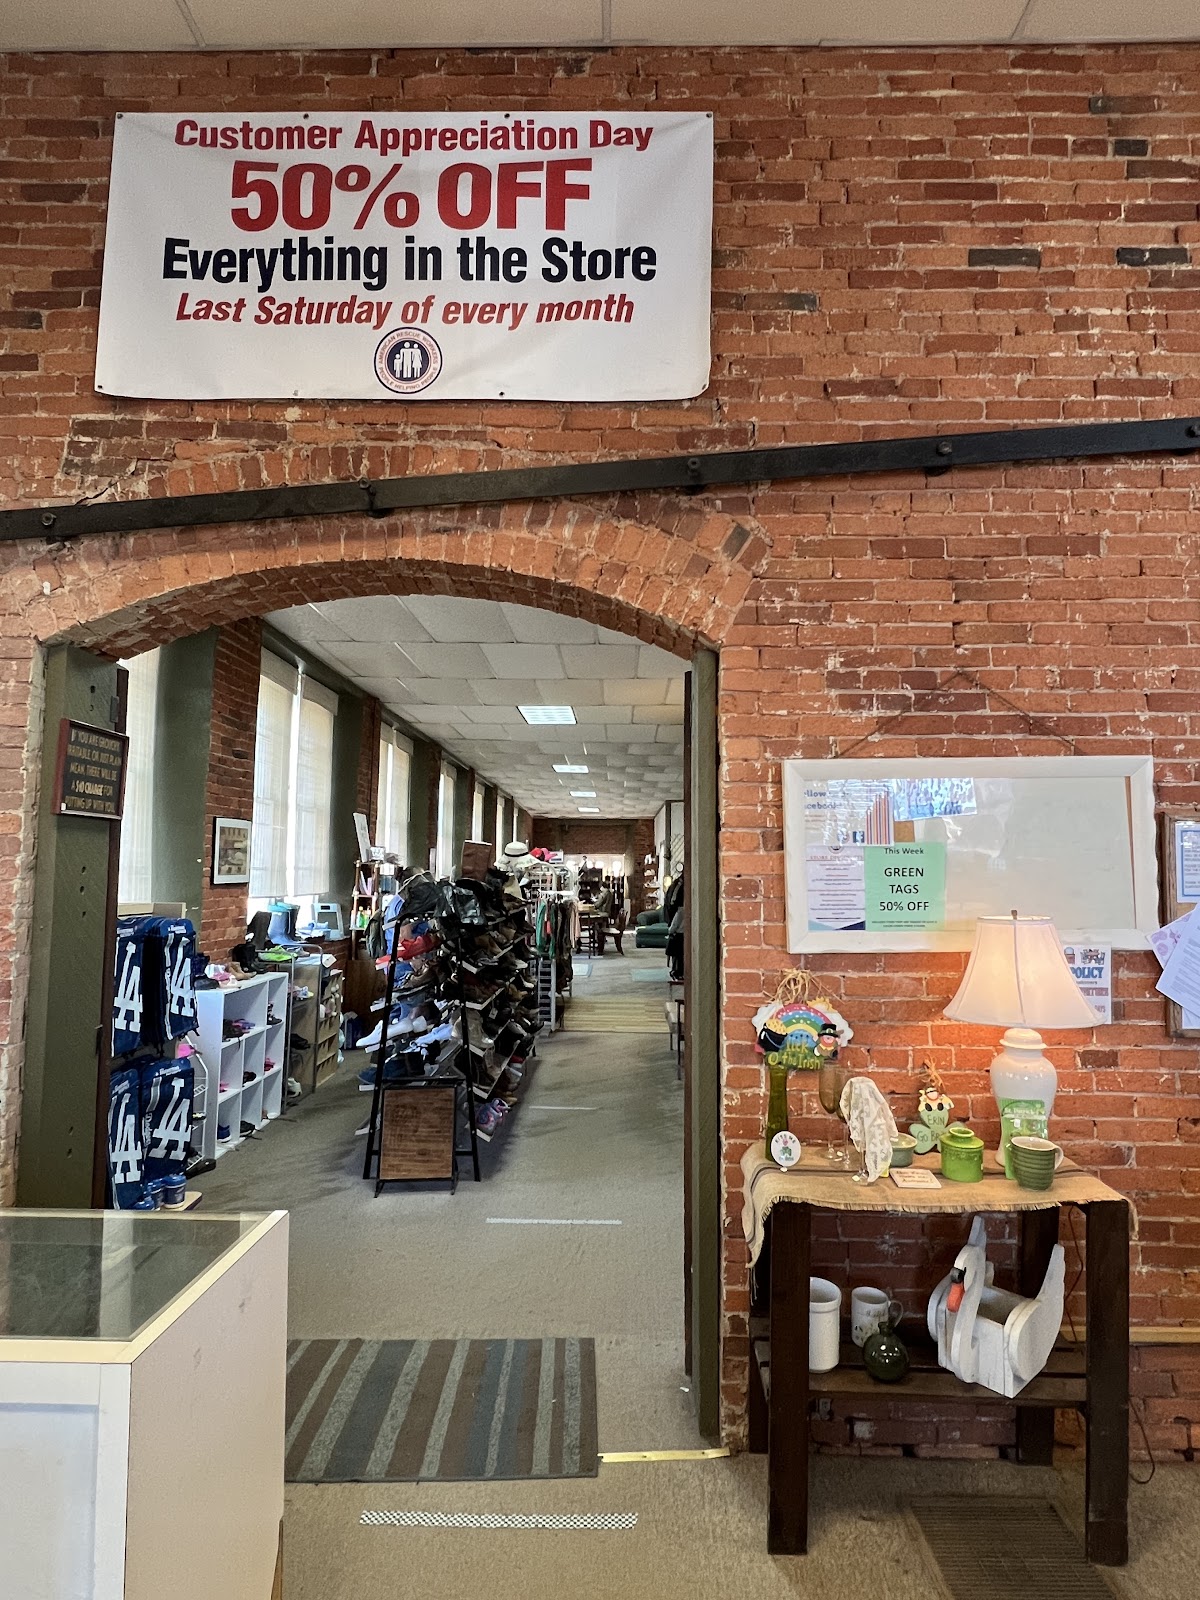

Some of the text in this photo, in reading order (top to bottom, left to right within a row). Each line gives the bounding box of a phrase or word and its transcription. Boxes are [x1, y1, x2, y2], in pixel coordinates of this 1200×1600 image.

[175, 120, 654, 157] Customer Appreciation Day
[231, 158, 593, 232] 50% OFF
[163, 235, 657, 292] Everything in the Store
[176, 292, 635, 331] Last Saturday of every month
[379, 336, 396, 364] AMERICAN
[422, 336, 438, 364] WORKERS
[379, 367, 395, 386] PEOPLE
[421, 368, 437, 386] PEOPLE
[804, 789, 827, 797] llow
[884, 847, 924, 855] This Week
[884, 867, 924, 877] GREEN
[889, 884, 919, 894] TAGS
[879, 901, 930, 911] 50% OFF
[114, 941, 143, 1033] LA
[170, 936, 196, 1017] LA
[797, 1053, 821, 1070] Irish
[149, 1077, 192, 1161] LA
[927, 1115, 945, 1126] ERIN
[111, 1093, 143, 1184] LA
